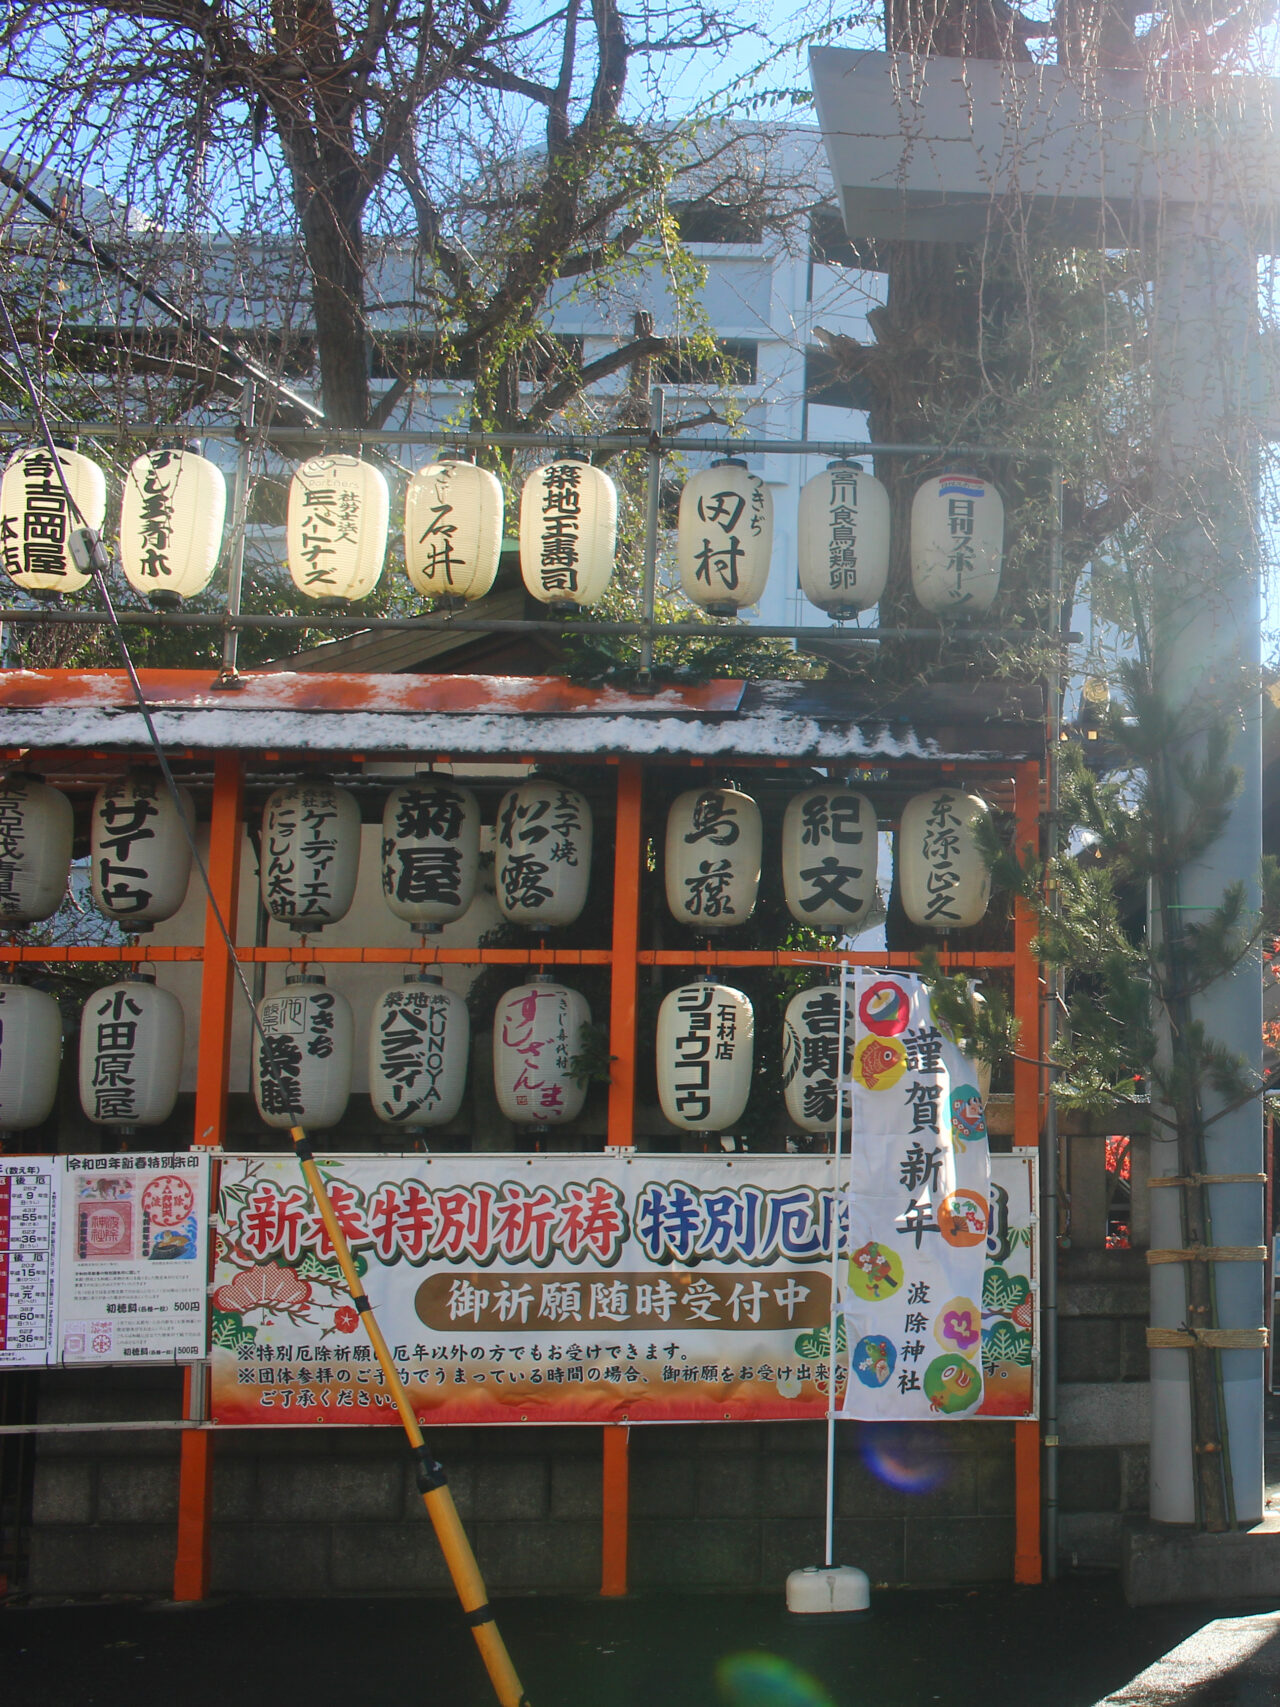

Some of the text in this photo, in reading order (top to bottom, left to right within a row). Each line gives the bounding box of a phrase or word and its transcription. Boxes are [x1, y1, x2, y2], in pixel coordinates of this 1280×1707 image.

[308, 479, 359, 489] partners
[334, 490, 361, 544] 社労士法人
[748, 475, 766, 537] つきぢ
[829, 470, 858, 590] 宮川食鳥鶏卵
[1, 515, 23, 576] 本店
[419, 504, 466, 585] 石井
[694, 491, 745, 590] 田村
[947, 498, 976, 605] 日刊スポーツ
[99, 800, 159, 913] サイトウ
[299, 810, 338, 917] ケーディーエム
[500, 792, 554, 911] 松露
[684, 791, 739, 917] 鳥藤
[799, 795, 864, 913] 紀文
[921, 796, 962, 921] 東源正久
[92, 990, 143, 1119] 小田原屋
[307, 992, 336, 1059] つきぢ
[380, 1007, 428, 1121] パラディーゾ
[674, 987, 715, 1121] ジョウコウ
[715, 1003, 737, 1060] 石材店
[802, 992, 855, 1122] 吉野家
[897, 1025, 946, 1249] 謹賀新年
[245, 1184, 621, 1258] 新春特別祈祷
[174, 1302, 200, 1312] 500円
[177, 1346, 198, 1355] 500円
[447, 1278, 812, 1323] 御祈願随時受付中
[897, 1281, 931, 1394] 波除神社
[237, 1342, 688, 1363] ※特別厄除祈願厄年以外の方でもお受けできます。
[260, 1388, 400, 1411] ご了承ください。
